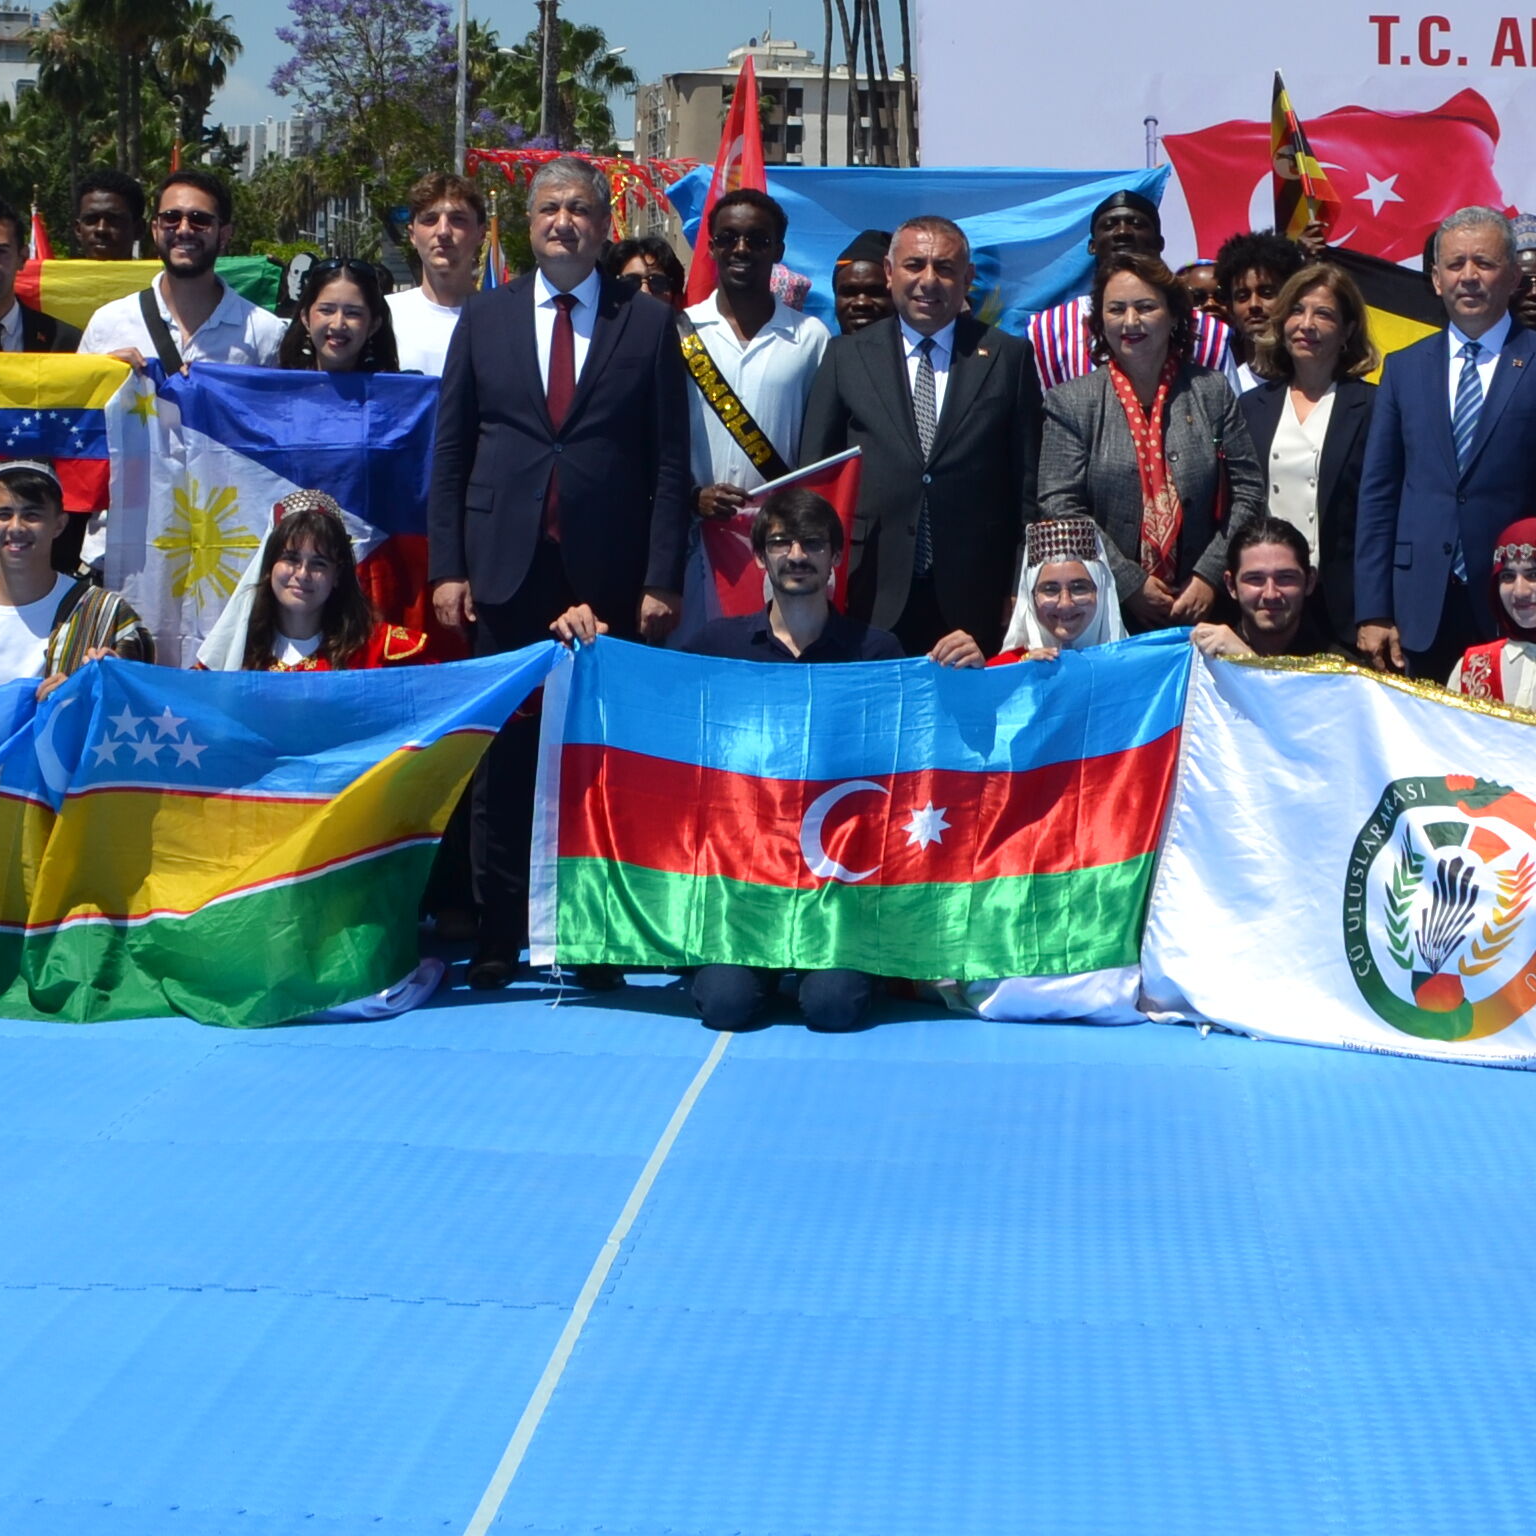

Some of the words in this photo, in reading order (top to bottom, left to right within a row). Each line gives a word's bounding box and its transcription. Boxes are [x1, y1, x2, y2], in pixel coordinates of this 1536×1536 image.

[1369, 15, 1469, 67] T.C.
[1347, 783, 1427, 933] ULUSLARARASI
[1348, 944, 1372, 977] ÇÜ
